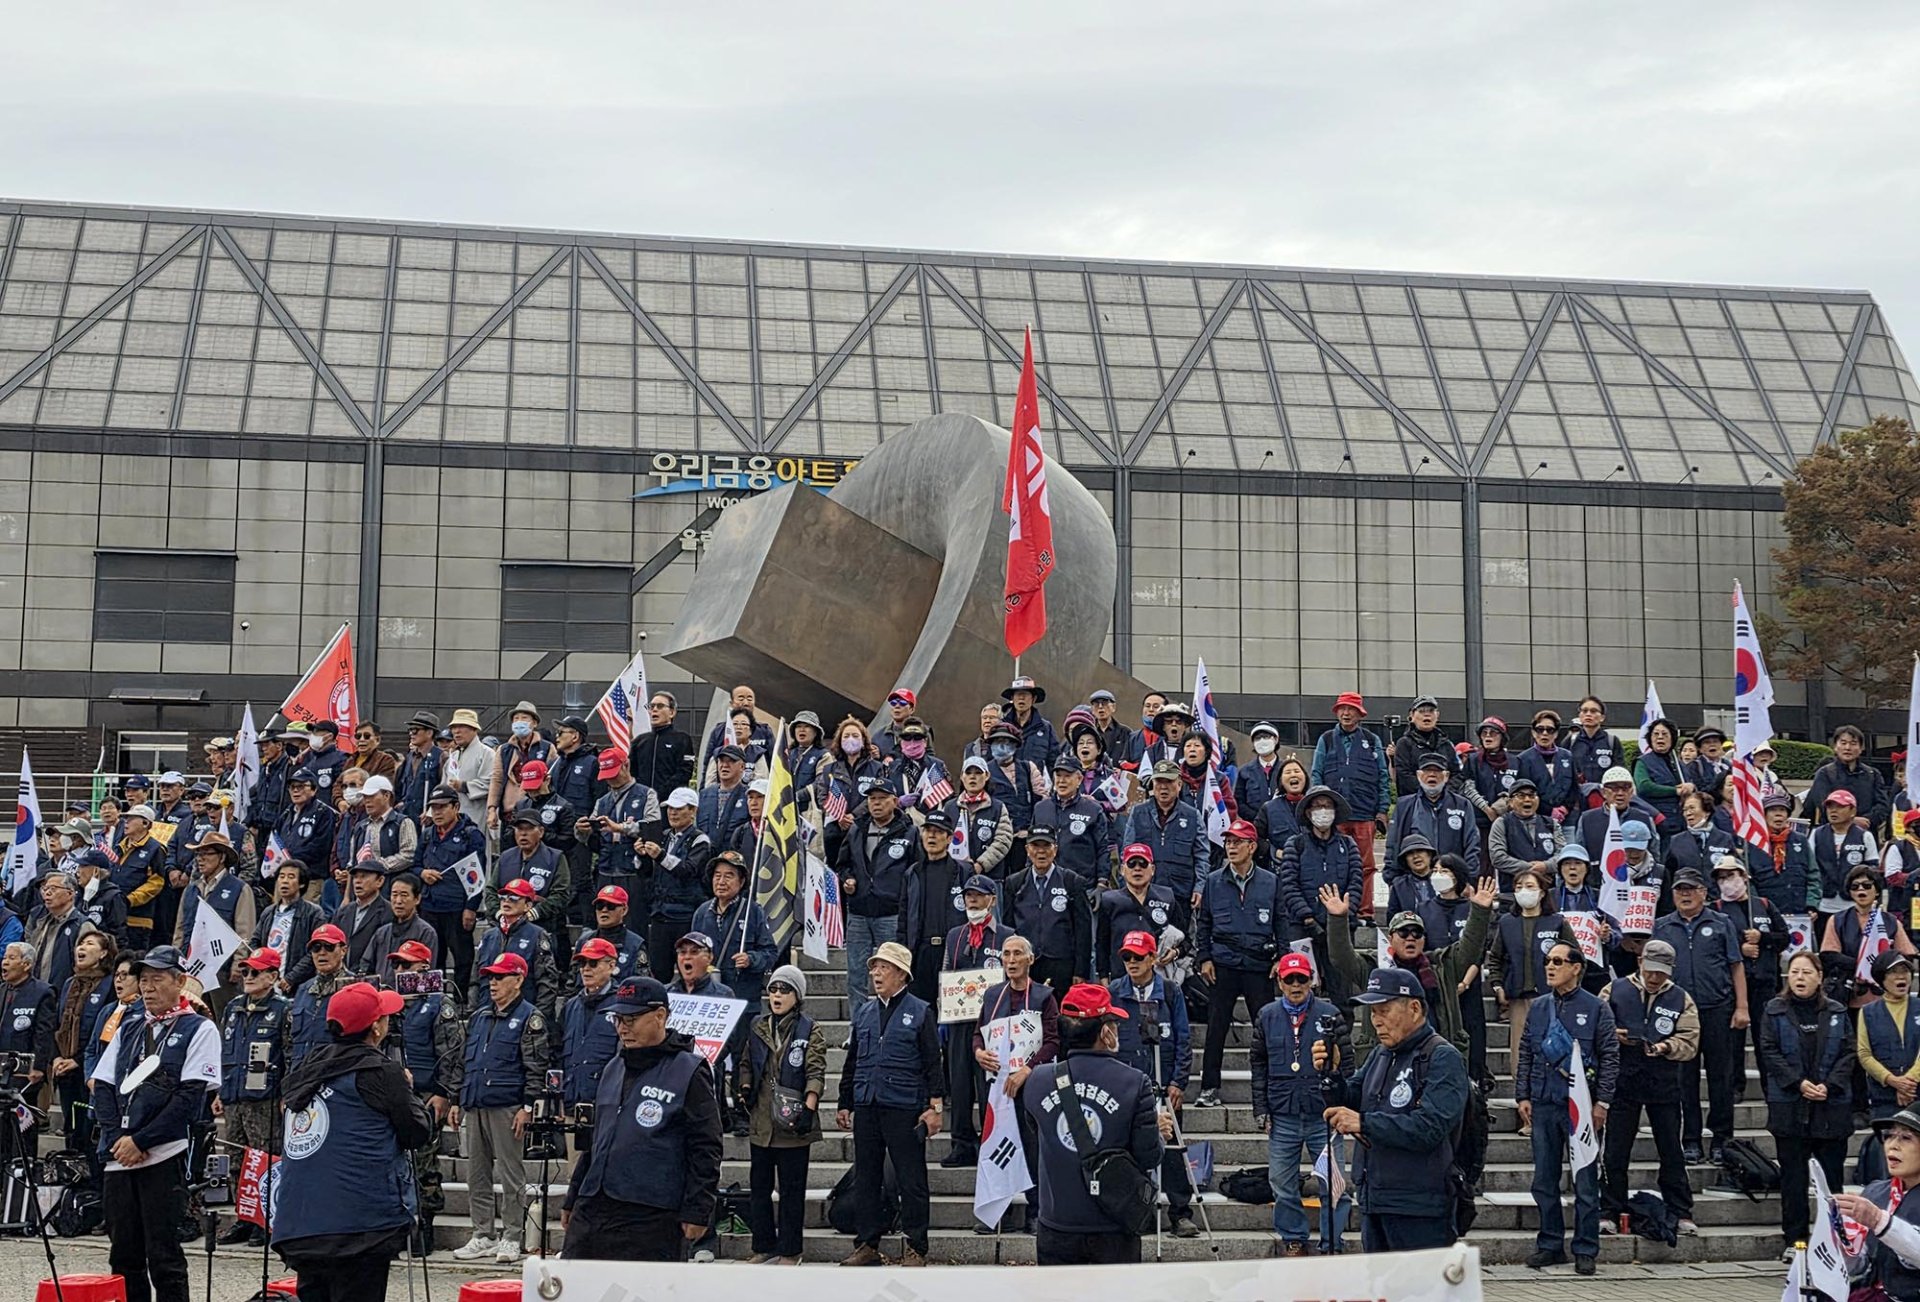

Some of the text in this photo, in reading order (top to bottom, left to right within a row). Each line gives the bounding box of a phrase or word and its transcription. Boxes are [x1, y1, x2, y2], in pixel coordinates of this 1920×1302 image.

[649, 453, 858, 490] 우리금융아트
[1069, 813, 1091, 821] OSVT
[977, 818, 997, 829] OSVT
[529, 866, 551, 877] OSVT
[1148, 899, 1170, 910] OSVT
[984, 947, 1002, 957] OSV
[699, 1002, 731, 1019] 특검은
[1655, 1006, 1680, 1020] OSVT
[640, 1085, 676, 1103] OSVT
[1041, 1082, 1120, 1115] 올공학검증단
